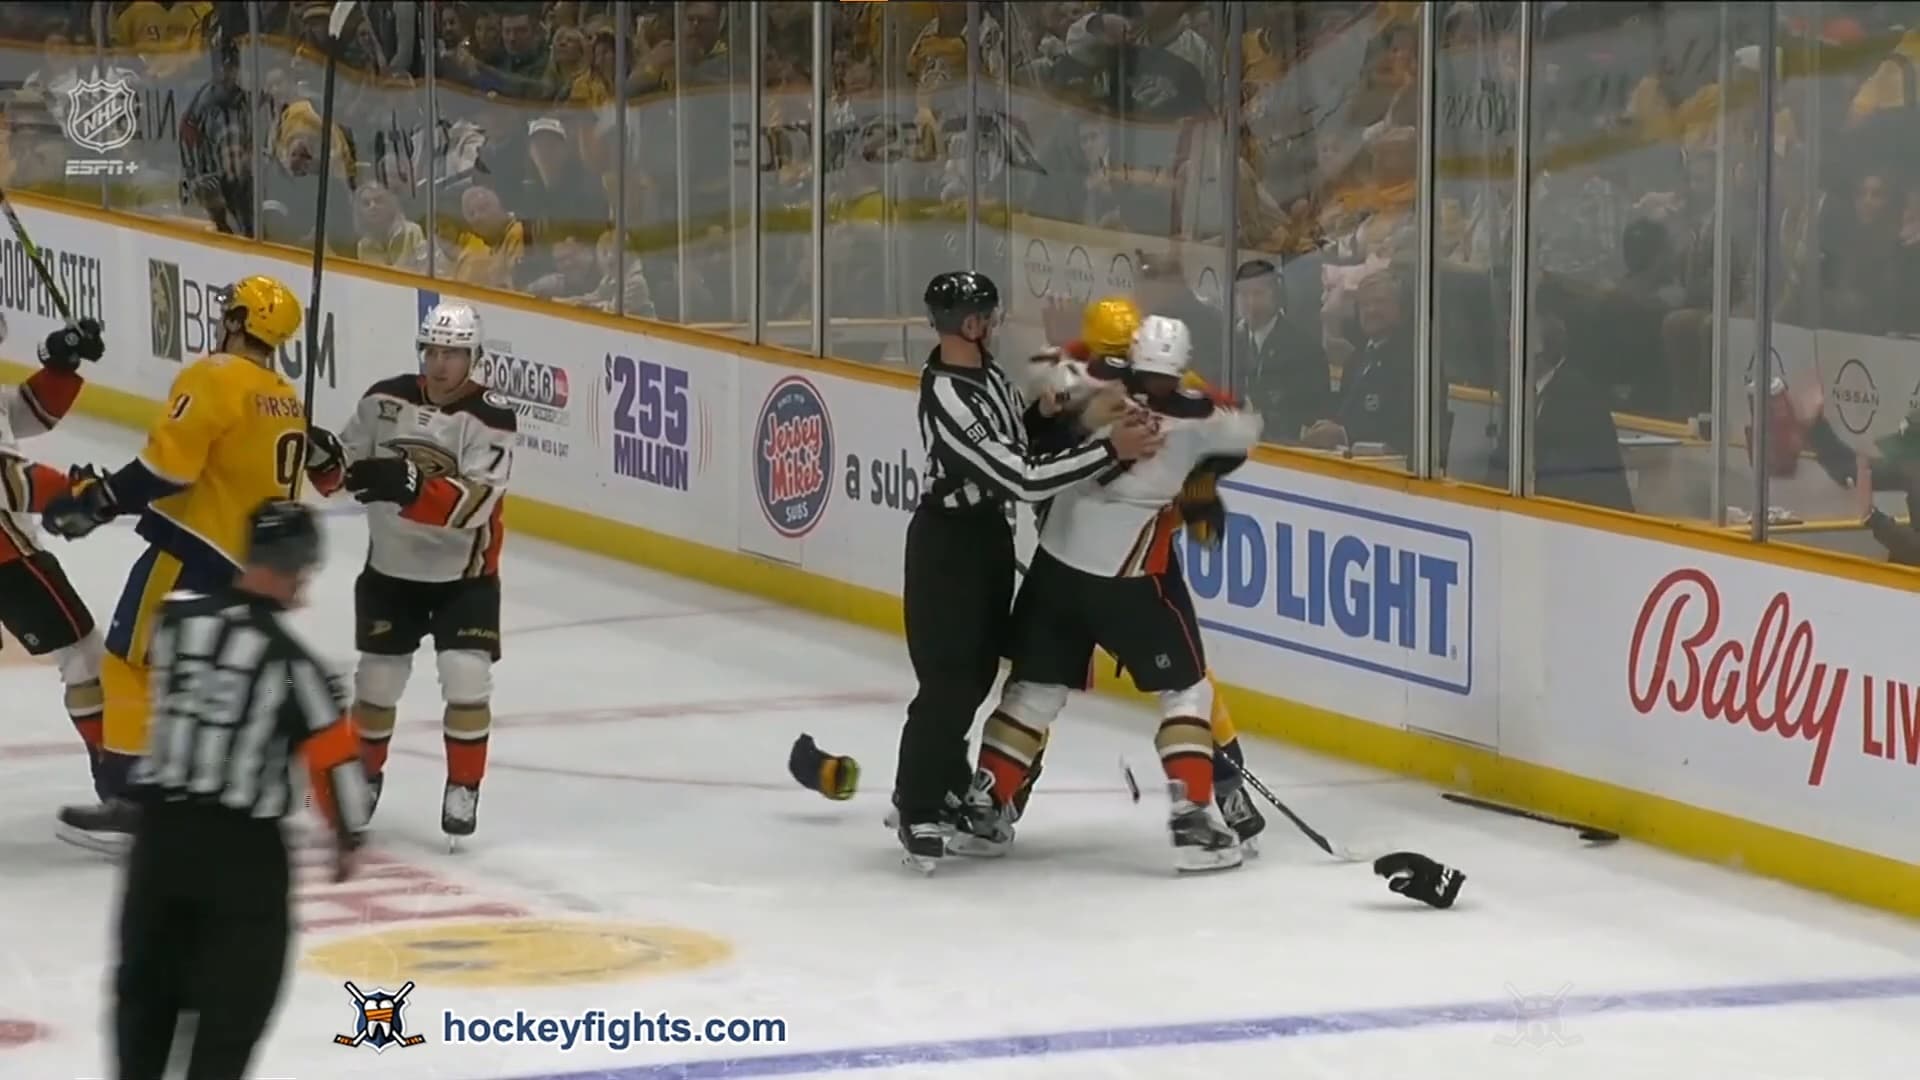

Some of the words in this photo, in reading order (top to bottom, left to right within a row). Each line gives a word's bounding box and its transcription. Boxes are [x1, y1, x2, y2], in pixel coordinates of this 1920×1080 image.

[0, 237, 57, 319] OOPER
[60, 250, 105, 331] STEEL
[168, 392, 192, 420] 9
[1832, 387, 1879, 407] NISSAN
[966, 422, 987, 443] 90
[614, 433, 688, 491] MILLION
[846, 453, 860, 500] a
[870, 448, 919, 513] sub
[786, 502, 808, 522] SUBS
[1276, 521, 1459, 658] LIGHT
[1628, 567, 1850, 787] Bally
